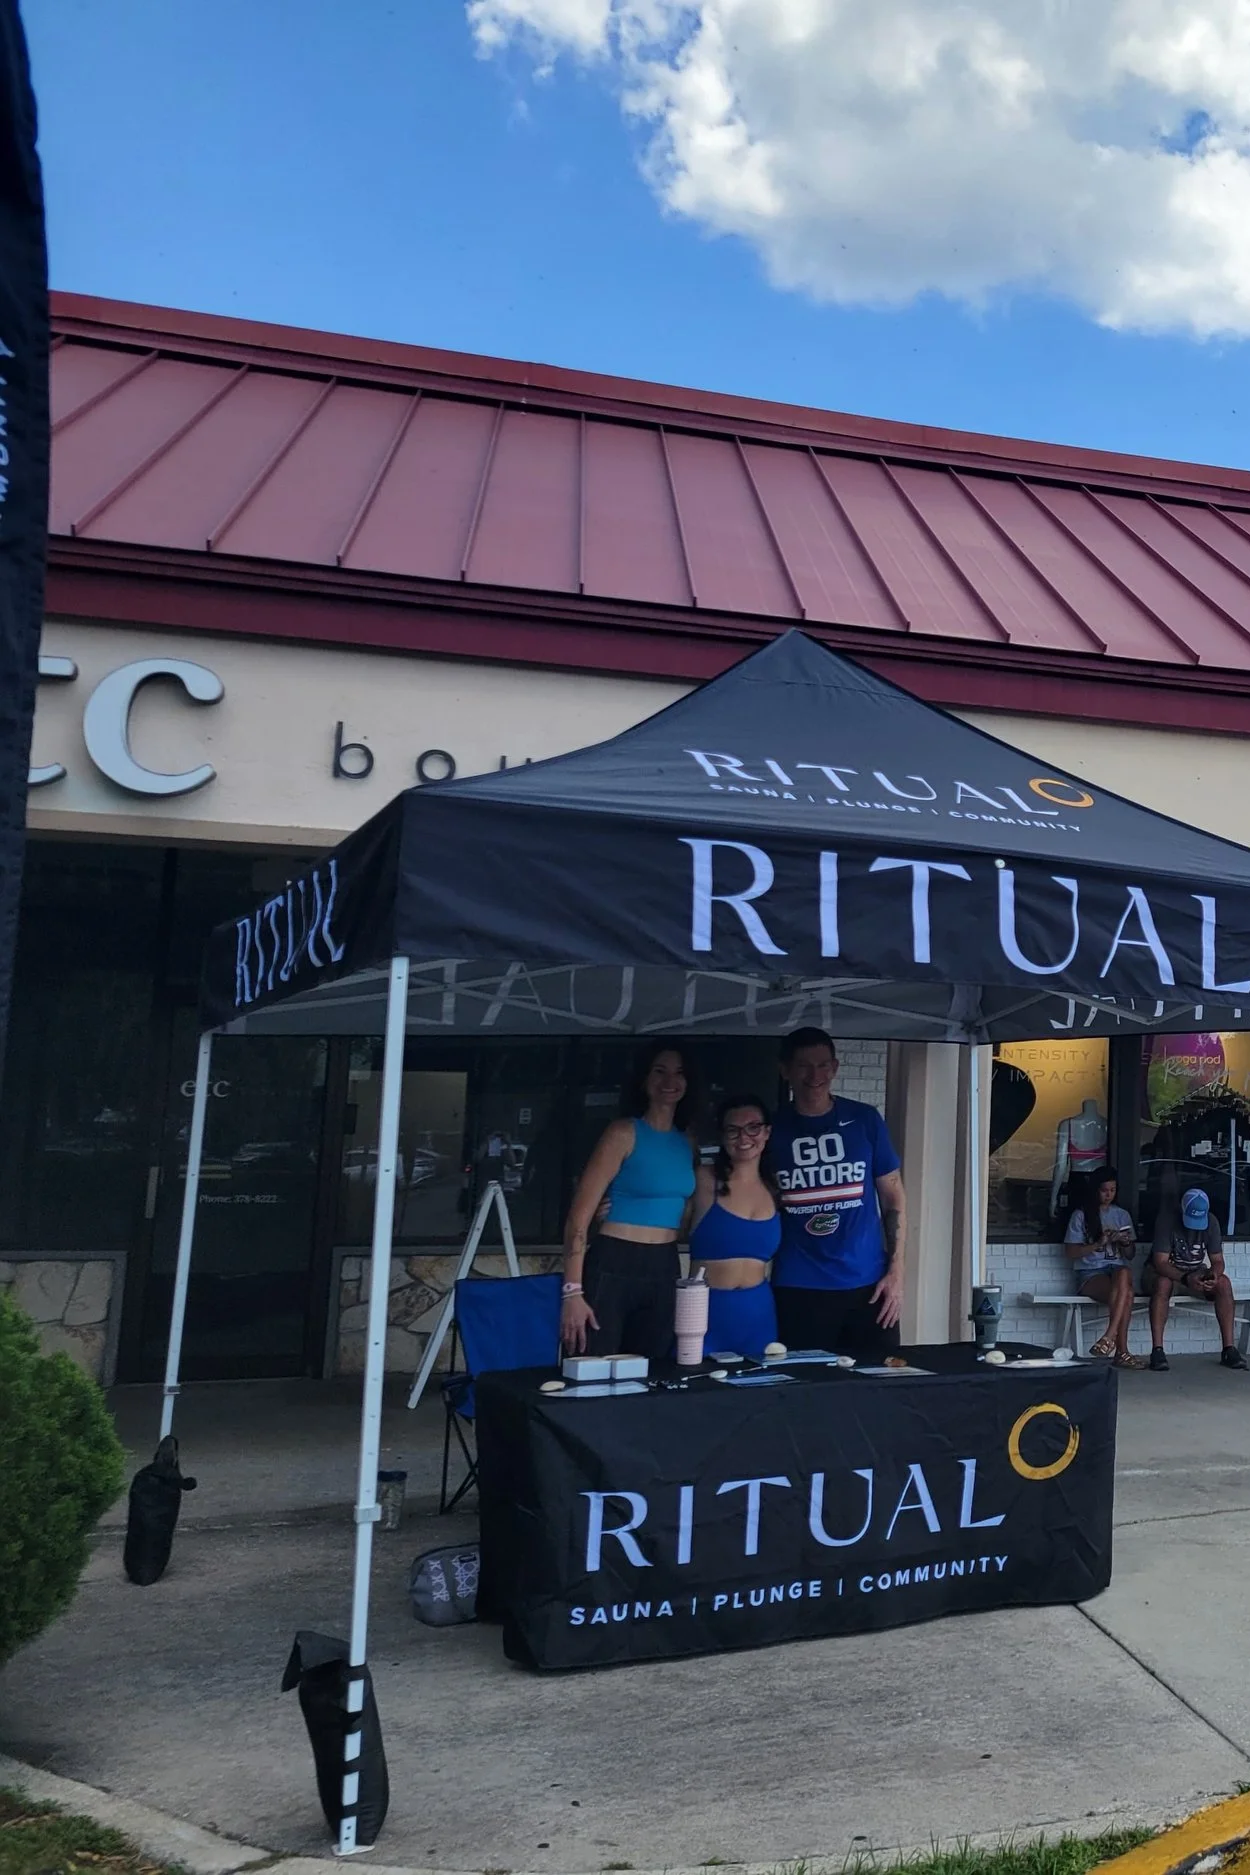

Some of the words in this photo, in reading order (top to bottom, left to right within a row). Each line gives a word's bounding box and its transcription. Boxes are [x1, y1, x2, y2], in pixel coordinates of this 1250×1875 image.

[683, 749, 1060, 816] RITUAL
[709, 784, 798, 801] SAUNA
[826, 797, 922, 814] PLUNGE
[949, 810, 1082, 833] COMMUNITY
[235, 860, 346, 1007] RITUAL
[1199, 1054, 1221, 1067] pod
[776, 1161, 866, 1190] GATORS
[791, 1132, 846, 1166] GO
[579, 1458, 1006, 1572] RITUAL
[569, 1600, 674, 1627] SAUNA
[713, 1580, 823, 1612] PLUNGE
[859, 1554, 1010, 1595] COMMUNITY
